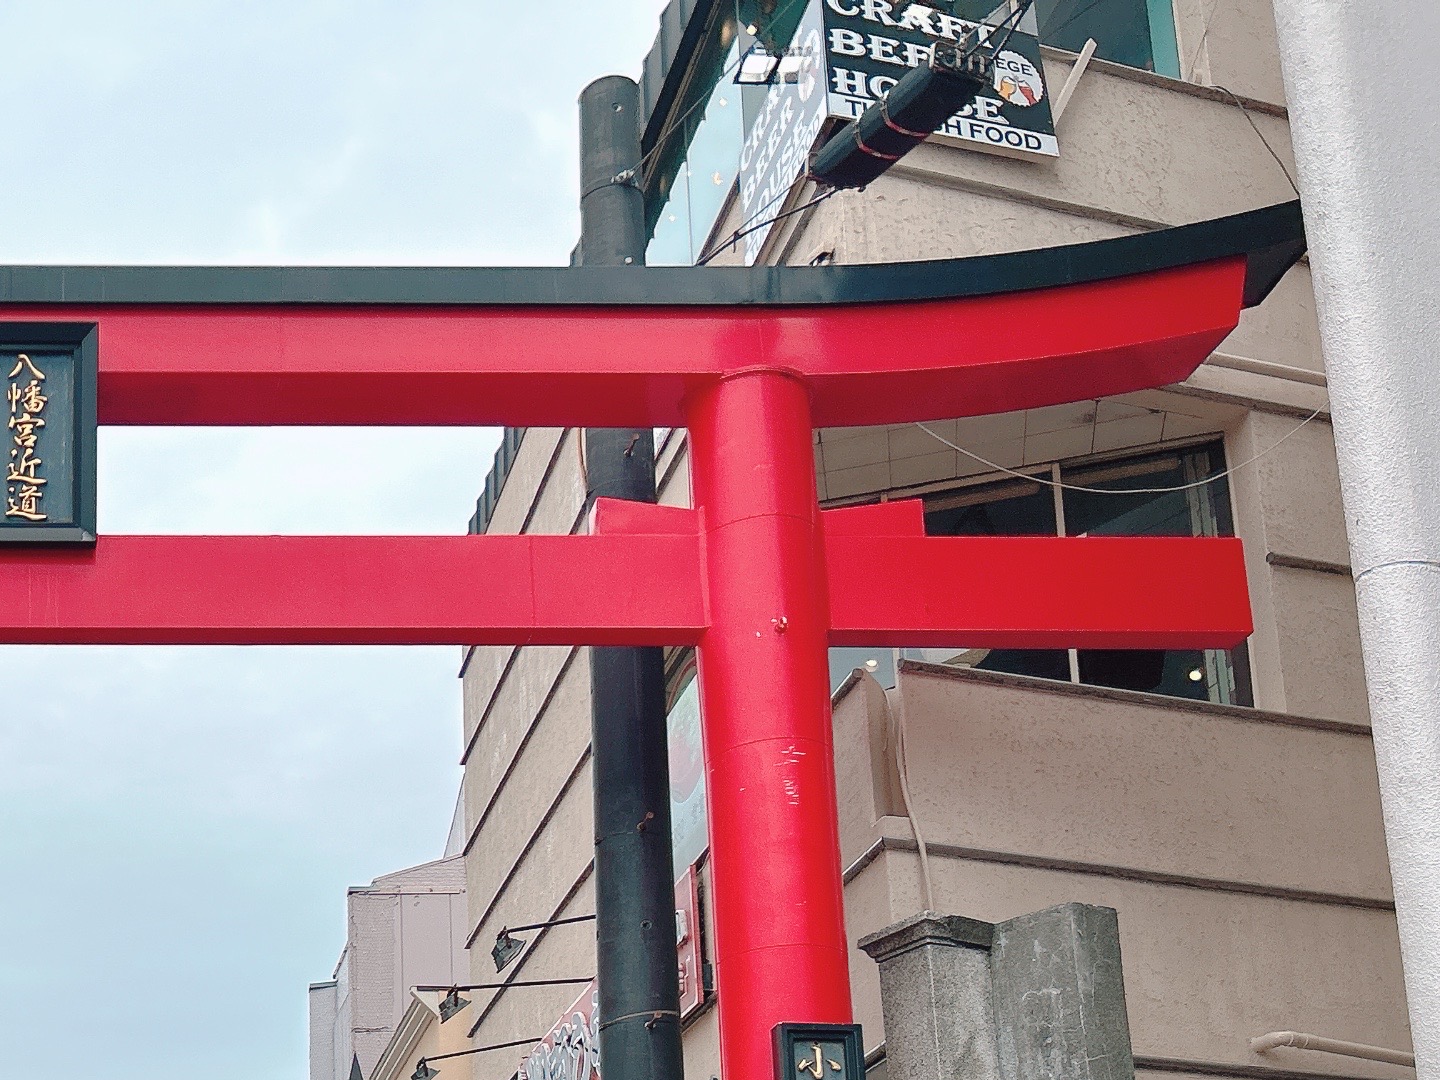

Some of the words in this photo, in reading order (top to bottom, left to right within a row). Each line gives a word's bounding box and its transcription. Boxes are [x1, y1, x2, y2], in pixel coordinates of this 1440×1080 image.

[827, 0, 994, 48] CRAFT
[971, 125, 1043, 151] FOOD
[5, 353, 49, 522] 八幡宮近道
